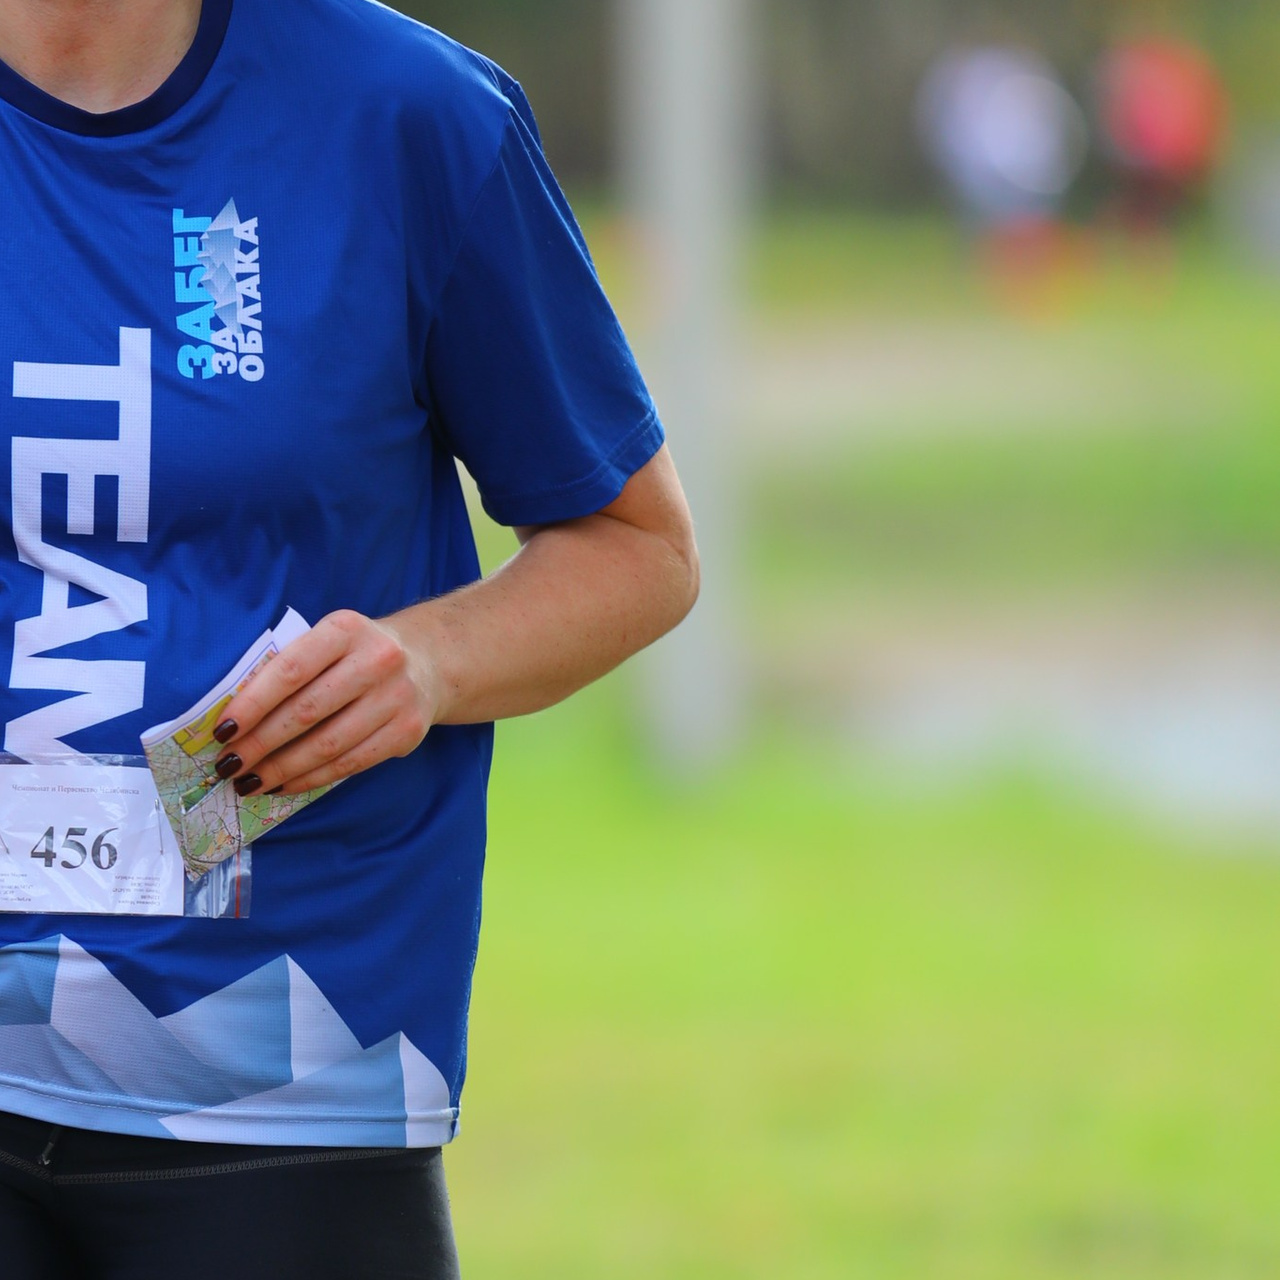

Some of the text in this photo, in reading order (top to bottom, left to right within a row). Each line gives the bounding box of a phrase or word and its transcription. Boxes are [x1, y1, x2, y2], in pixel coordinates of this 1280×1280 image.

[172, 208, 218, 380] ЗАБЕГ
[233, 216, 266, 383] ОБЛАКА
[209, 326, 238, 375] ЗА
[57, 784, 98, 795] Первенство
[30, 825, 119, 870] 456
